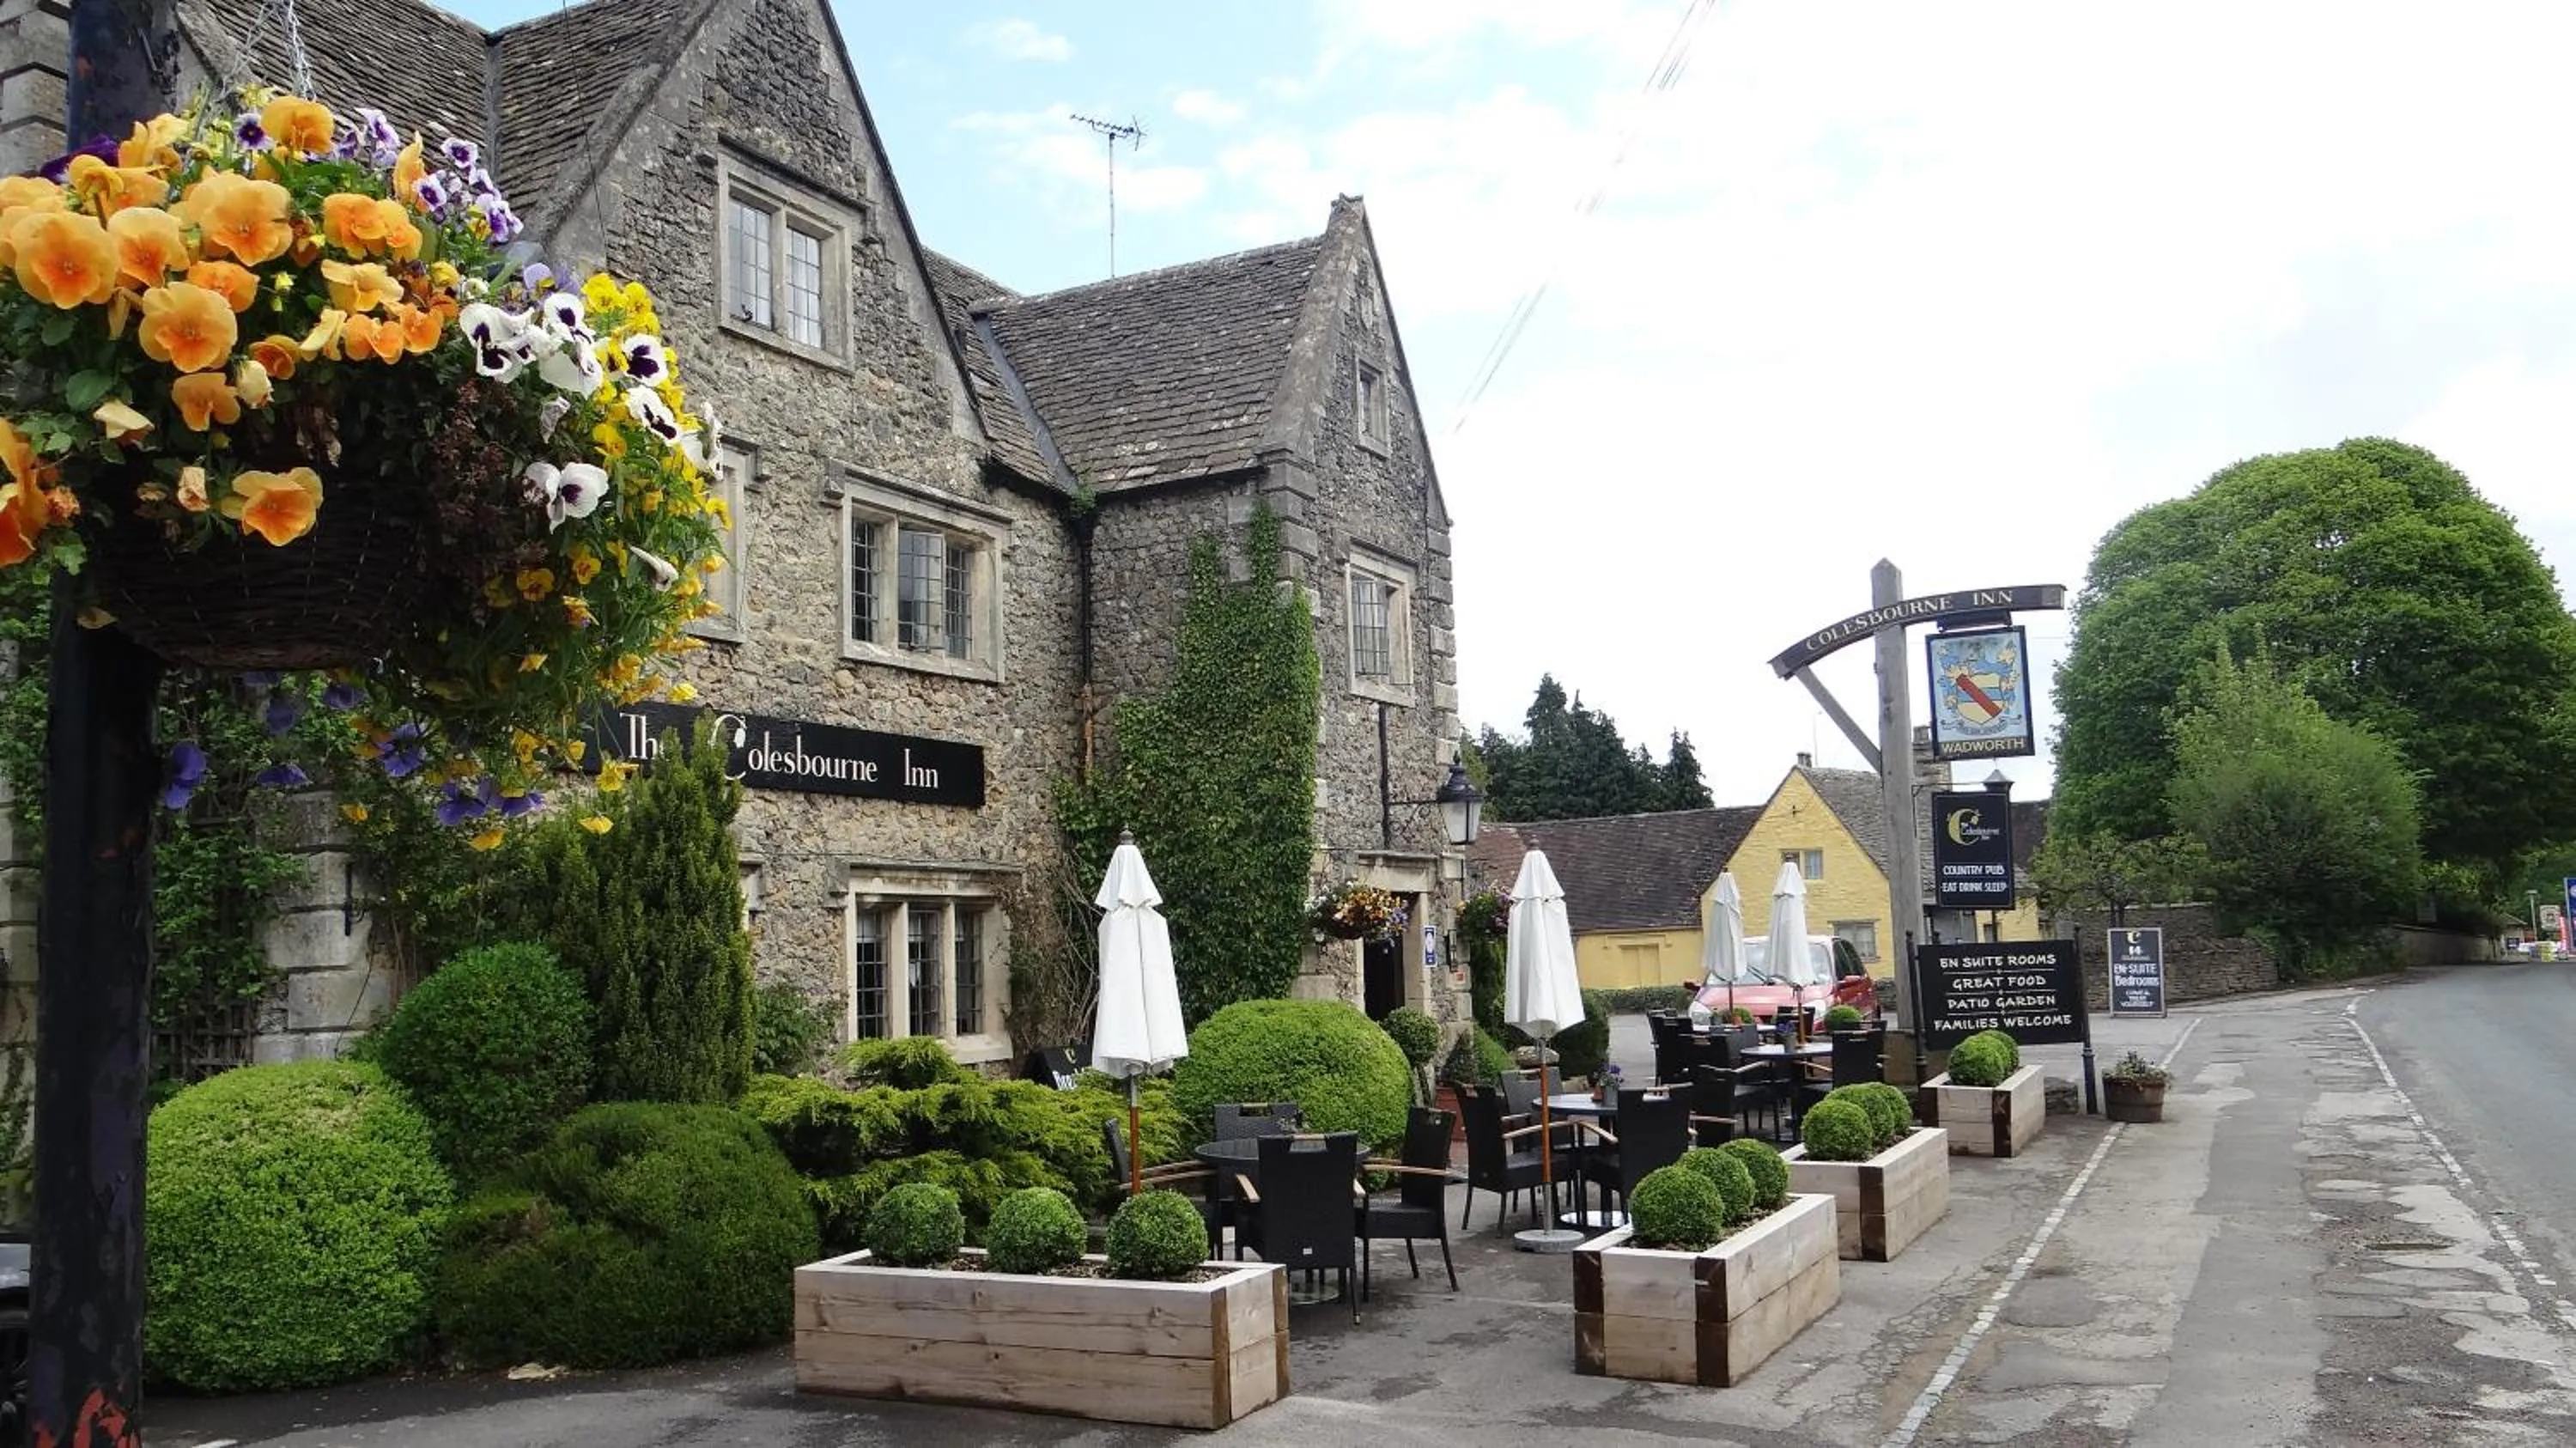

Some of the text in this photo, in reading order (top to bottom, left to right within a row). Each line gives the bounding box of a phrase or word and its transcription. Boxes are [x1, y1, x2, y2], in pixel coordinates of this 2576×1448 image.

[1806, 590, 2014, 651] COLESBOURNE INN
[1942, 738, 2025, 754] WADWORTH
[904, 748, 939, 789] Inn
[1942, 865, 2005, 875] COUNTRY PUB
[1941, 882, 1957, 892] EAT
[1940, 954, 2057, 969] EN SUITE ROOMS
[1953, 975, 2046, 991] GREAT FOOD
[1947, 995, 2055, 1009] PATIO GARDEN
[1934, 1014, 2072, 1031] FAMILIES WELCOME
